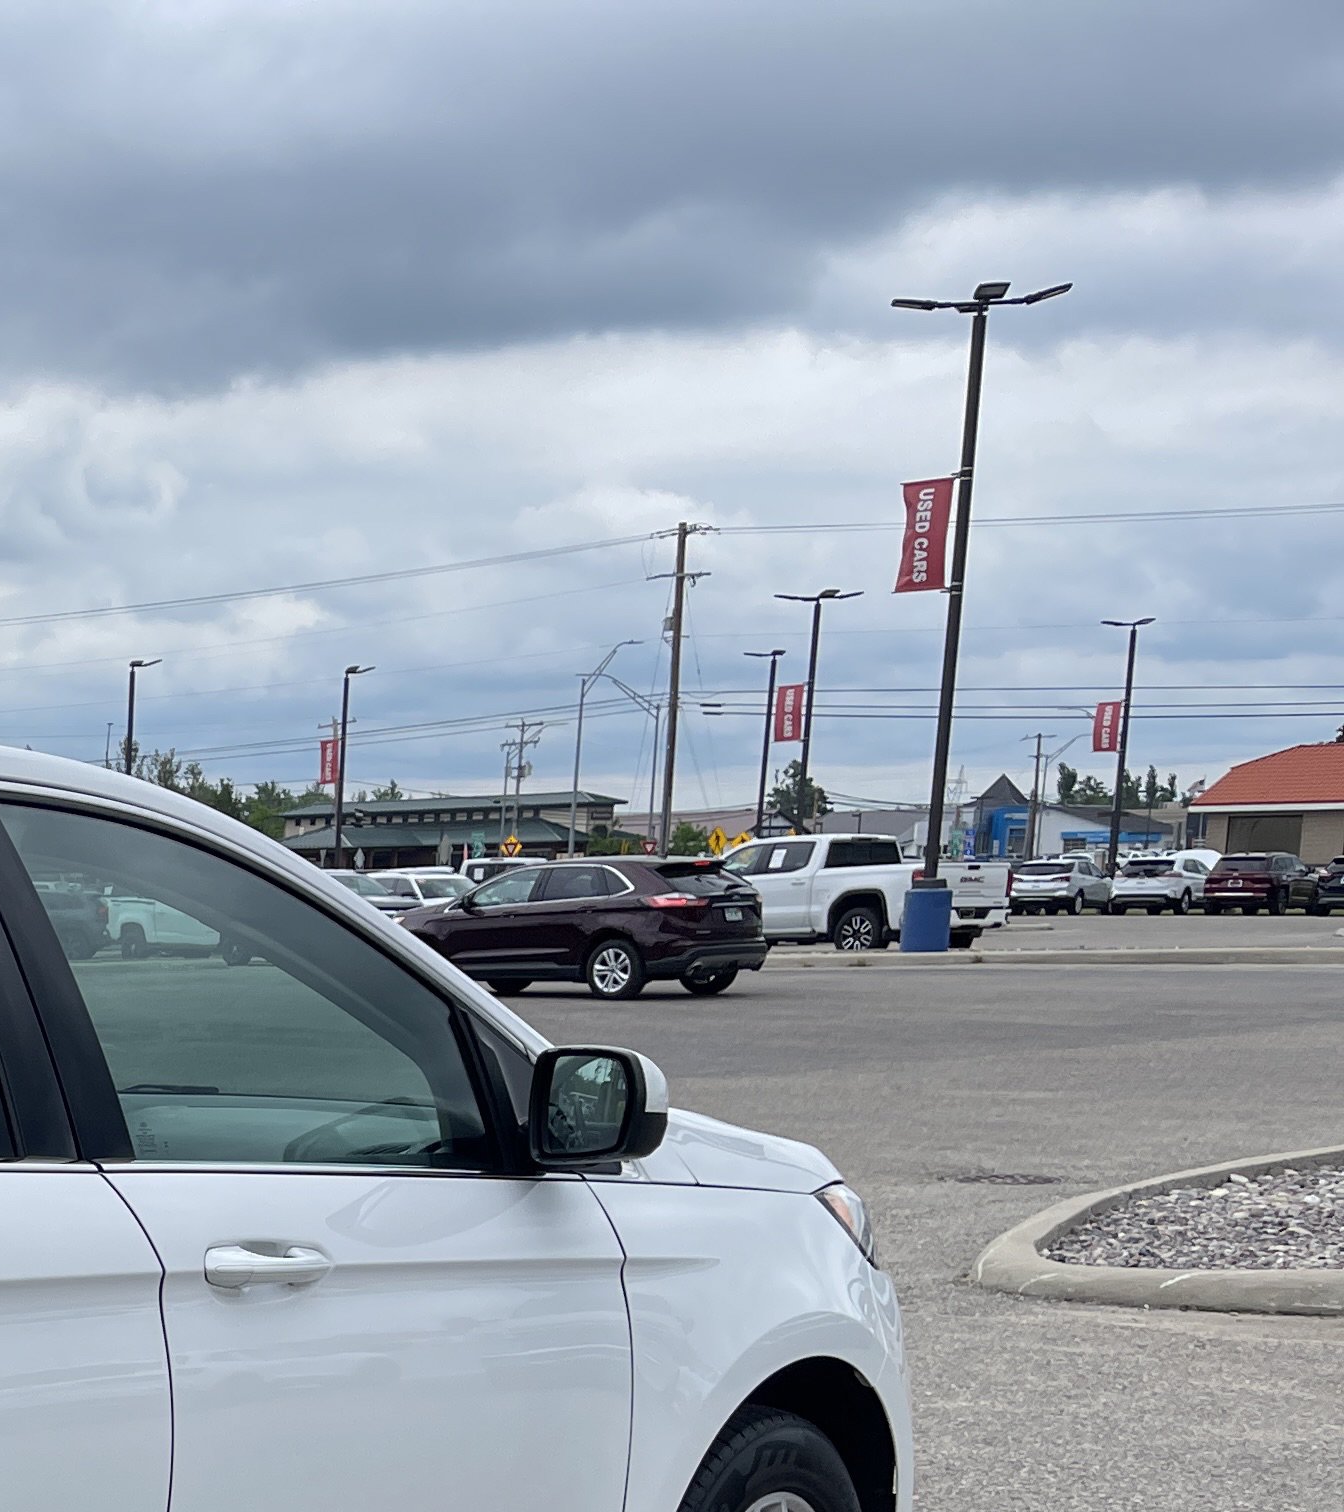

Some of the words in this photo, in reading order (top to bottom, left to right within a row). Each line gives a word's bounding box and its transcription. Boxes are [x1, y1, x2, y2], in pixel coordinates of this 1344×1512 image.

[914, 487, 936, 534] USED
[912, 537, 929, 583] CARS
[784, 688, 796, 713] USED
[783, 713, 794, 738] CARS
[959, 875, 985, 884] GMC
